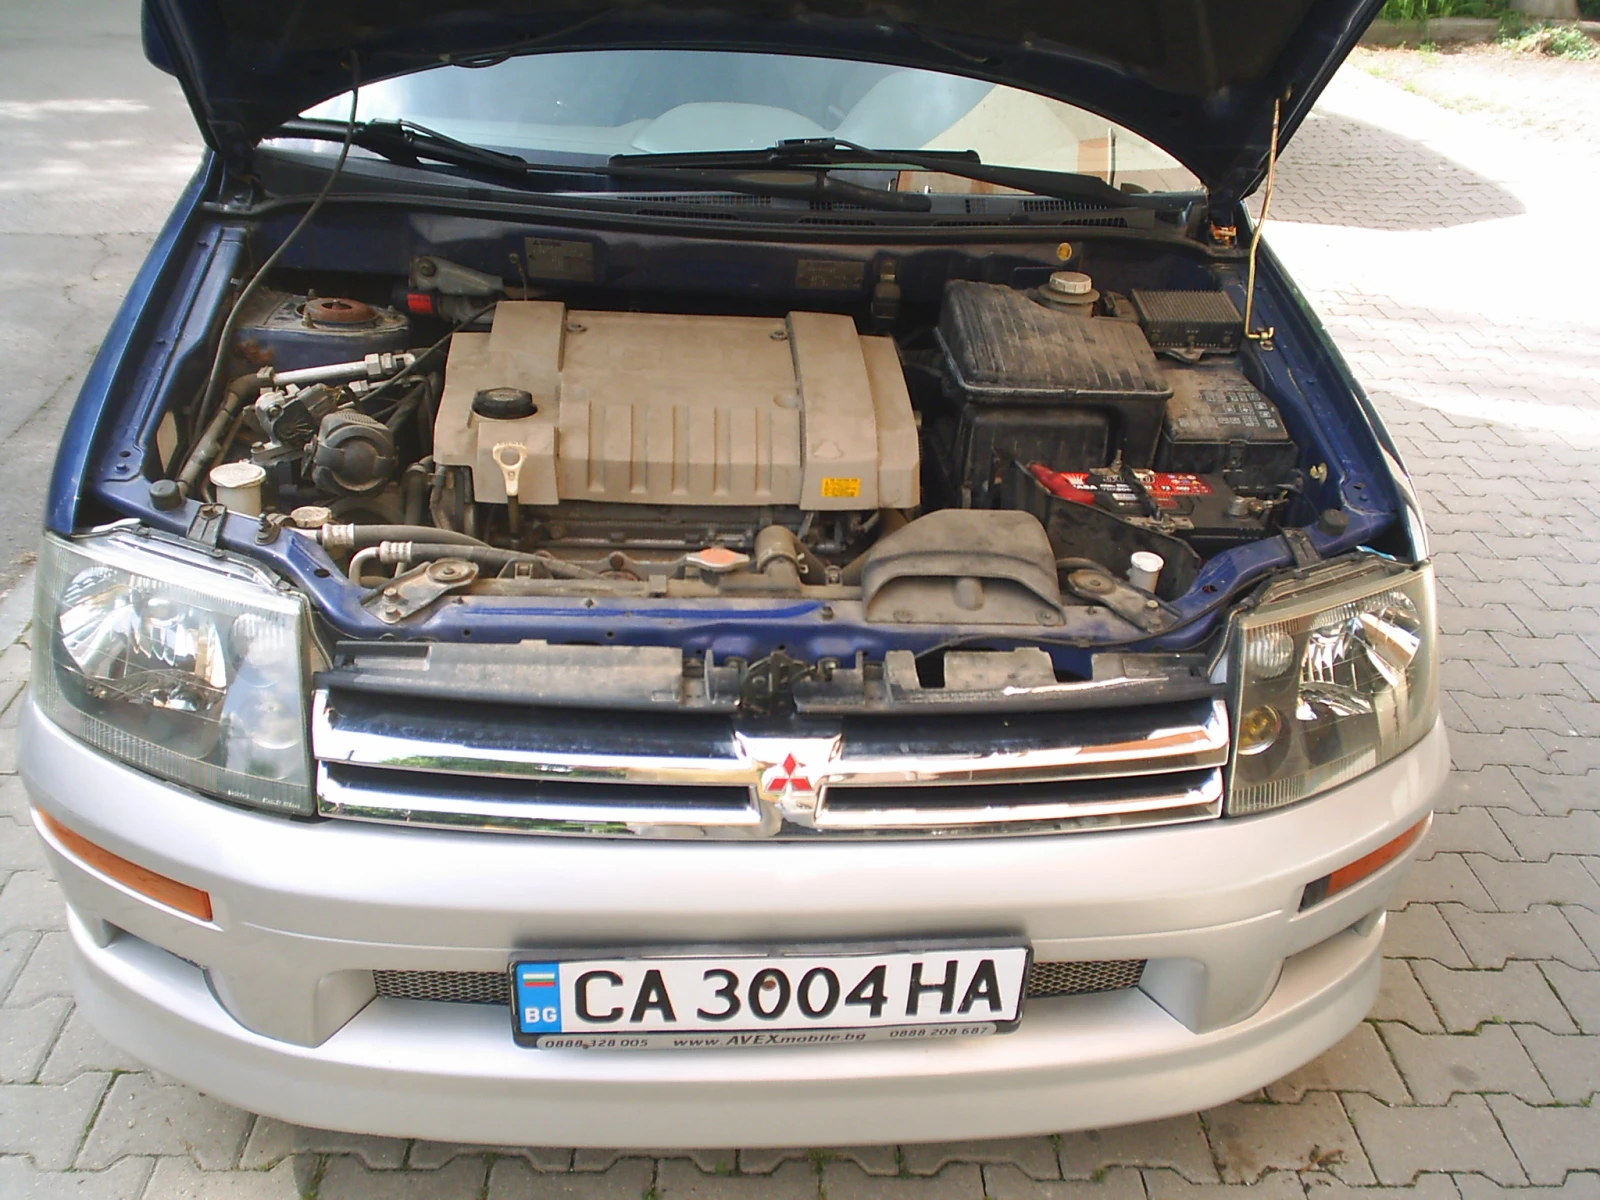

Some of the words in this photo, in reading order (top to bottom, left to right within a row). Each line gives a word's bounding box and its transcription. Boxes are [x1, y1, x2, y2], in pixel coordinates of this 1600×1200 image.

[574, 969, 677, 1024] CA
[696, 964, 888, 1022] 3004
[905, 959, 1003, 1017] HA
[524, 1006, 558, 1024] BG
[545, 1039, 583, 1048] 0888
[588, 1039, 616, 1047] 328
[620, 1038, 649, 1047] 005
[673, 1032, 867, 1047] www.AVEXmobile.bg
[889, 1028, 927, 1038] 0888
[930, 1027, 959, 1036] 208
[963, 1026, 989, 1035] 687
